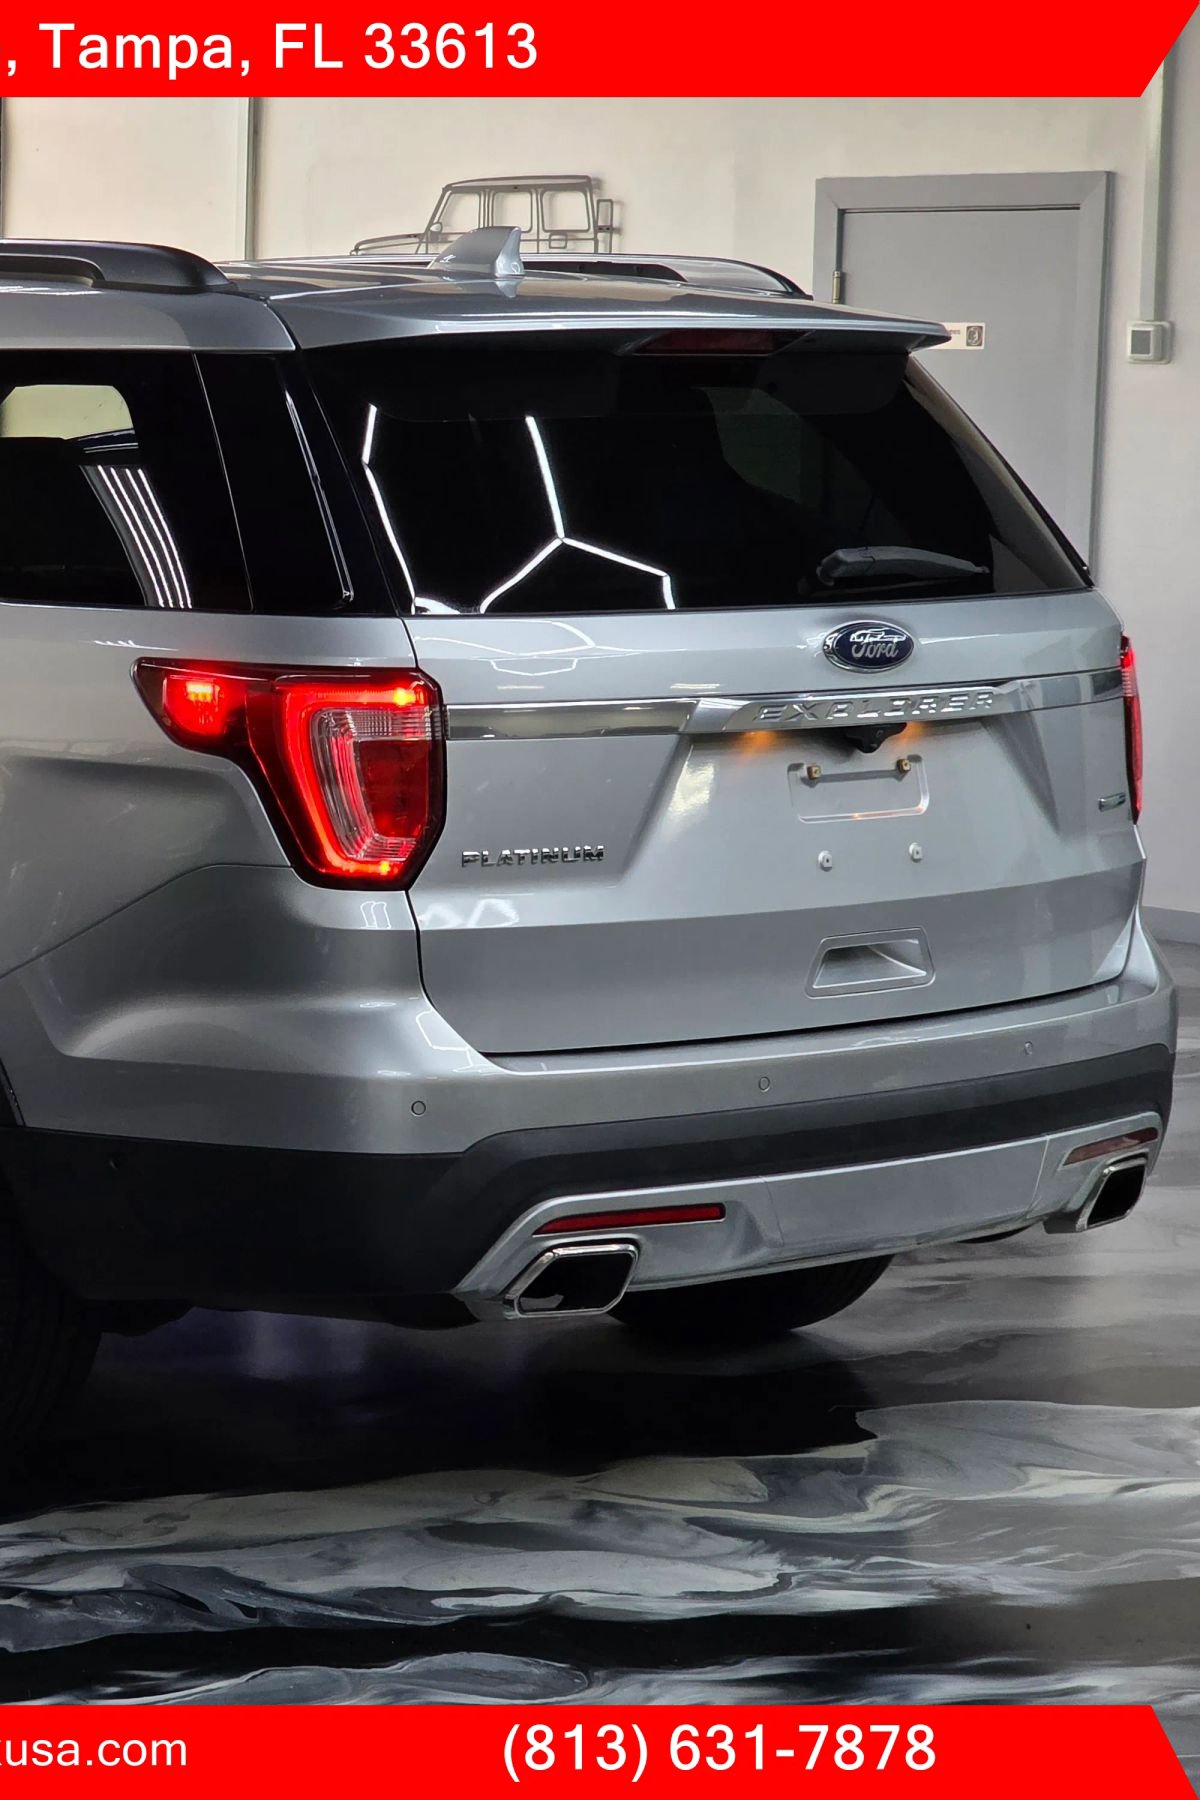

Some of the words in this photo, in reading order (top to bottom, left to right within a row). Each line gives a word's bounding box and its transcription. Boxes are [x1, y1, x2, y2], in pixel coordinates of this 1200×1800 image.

[849, 629, 902, 658] Ford
[754, 692, 994, 722] EXPLORER
[461, 845, 605, 868] PLATINUM
